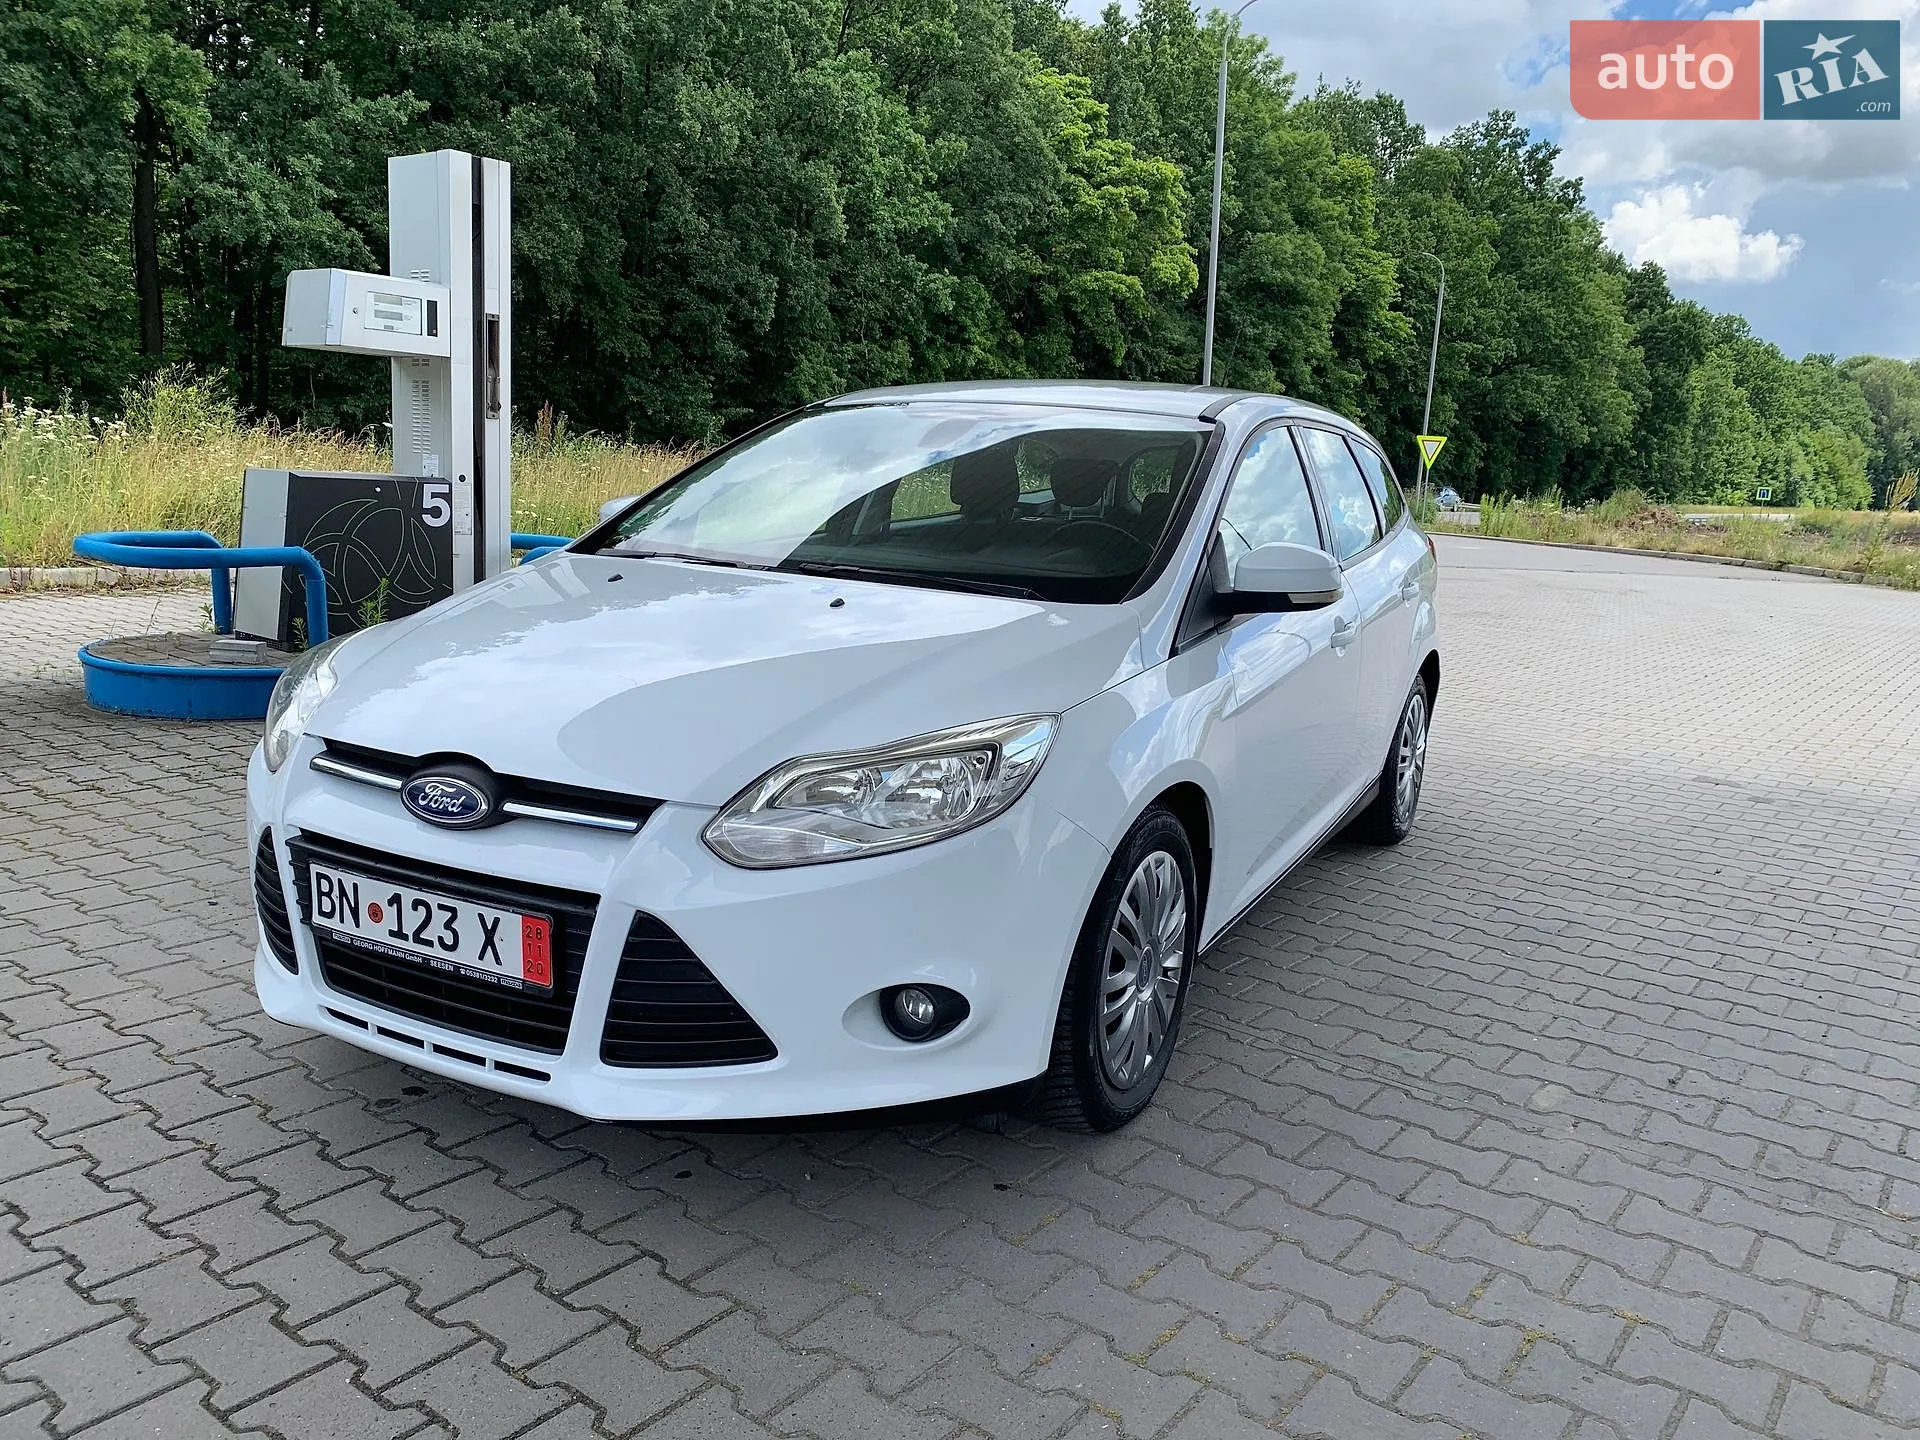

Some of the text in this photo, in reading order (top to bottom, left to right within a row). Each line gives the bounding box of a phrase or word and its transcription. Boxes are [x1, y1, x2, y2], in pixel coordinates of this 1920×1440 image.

[421, 483, 451, 527] 5
[418, 782, 466, 812] Ford
[315, 871, 503, 966] BN 123 X
[525, 924, 543, 940] 28
[353, 938, 373, 950] GEORG
[373, 944, 405, 959] HOFFMANN
[405, 953, 423, 964] GmbH
[430, 959, 454, 972] SEESEN
[527, 942, 542, 958] 11
[526, 959, 543, 975] 20
